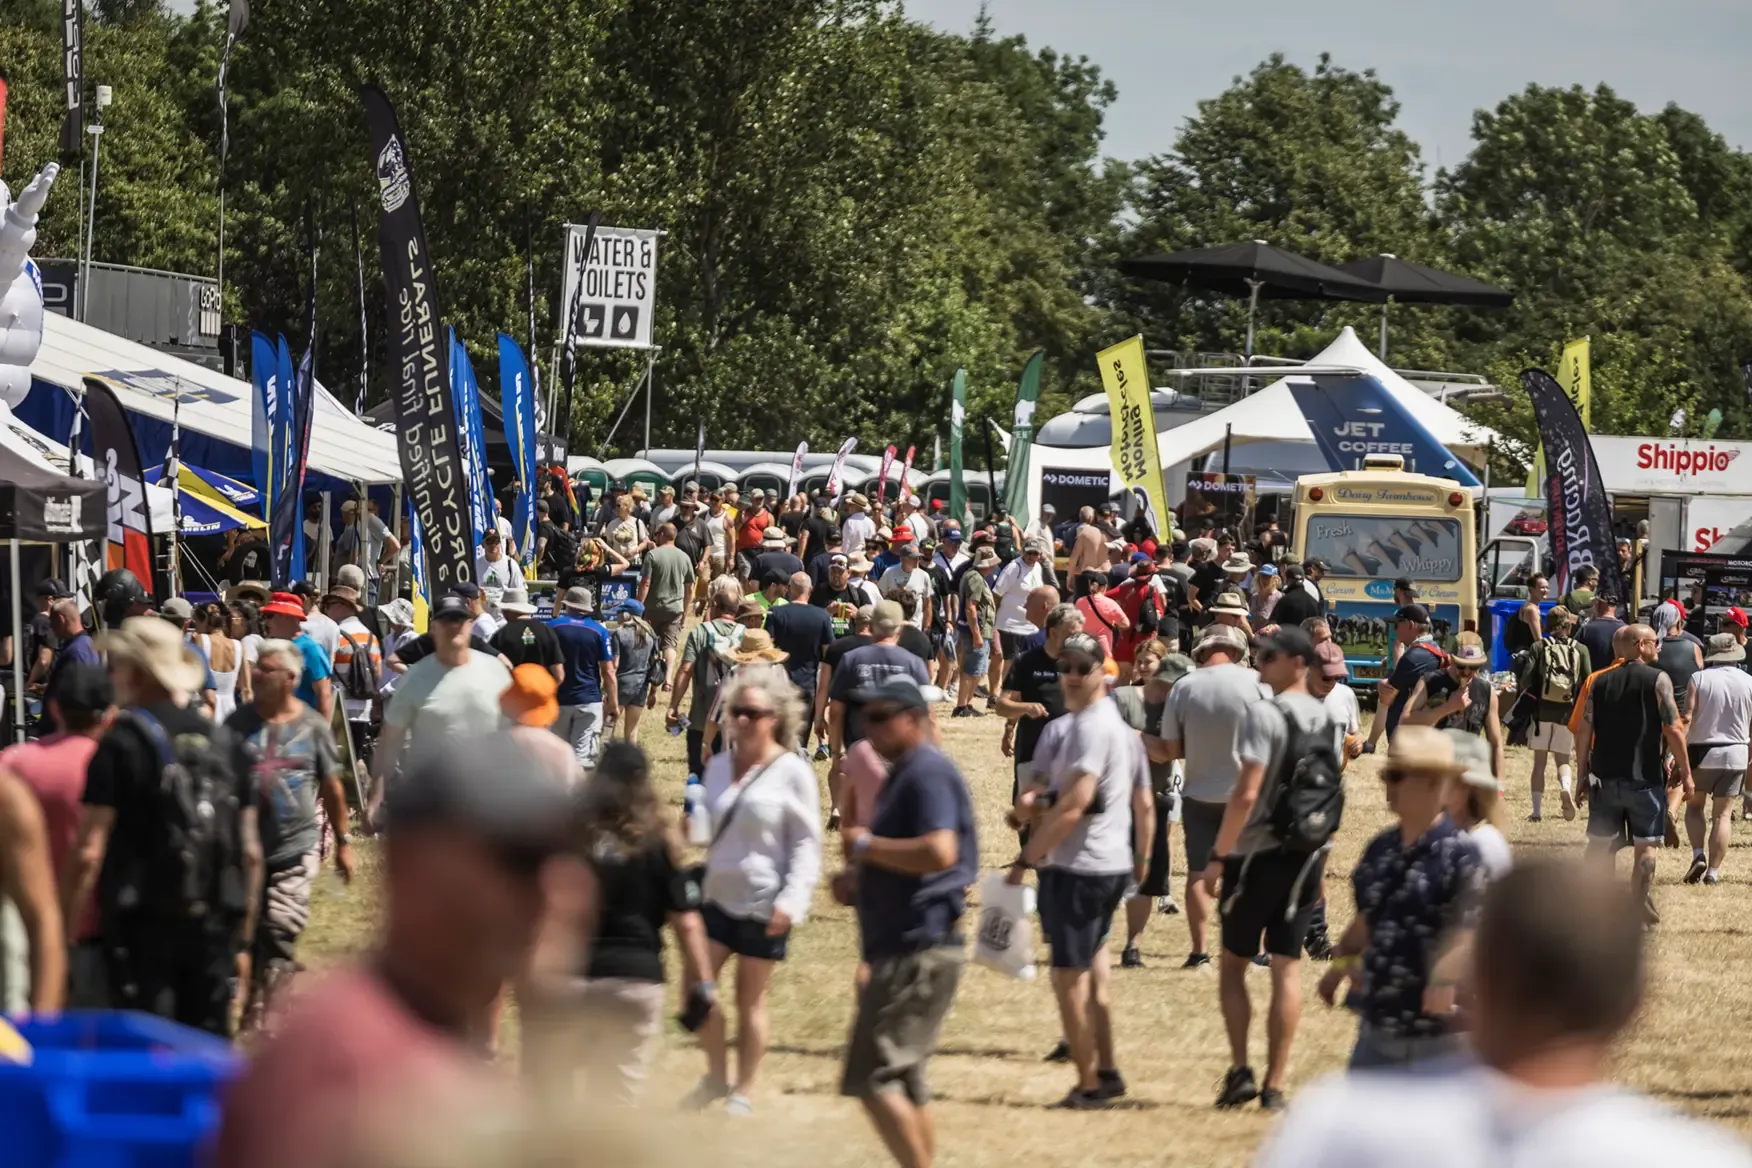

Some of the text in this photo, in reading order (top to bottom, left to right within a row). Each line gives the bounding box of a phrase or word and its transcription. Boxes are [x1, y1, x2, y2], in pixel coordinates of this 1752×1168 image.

[641, 240, 651, 268] &
[1334, 421, 1385, 437] JET
[1338, 441, 1413, 454] COFFEE
[1637, 443, 1729, 476] Shippio
[1058, 474, 1109, 486] DOMETIC
[1203, 481, 1254, 492] DOMETIC
[1316, 520, 1353, 540] Fresh
[1401, 555, 1454, 574] Whippy
